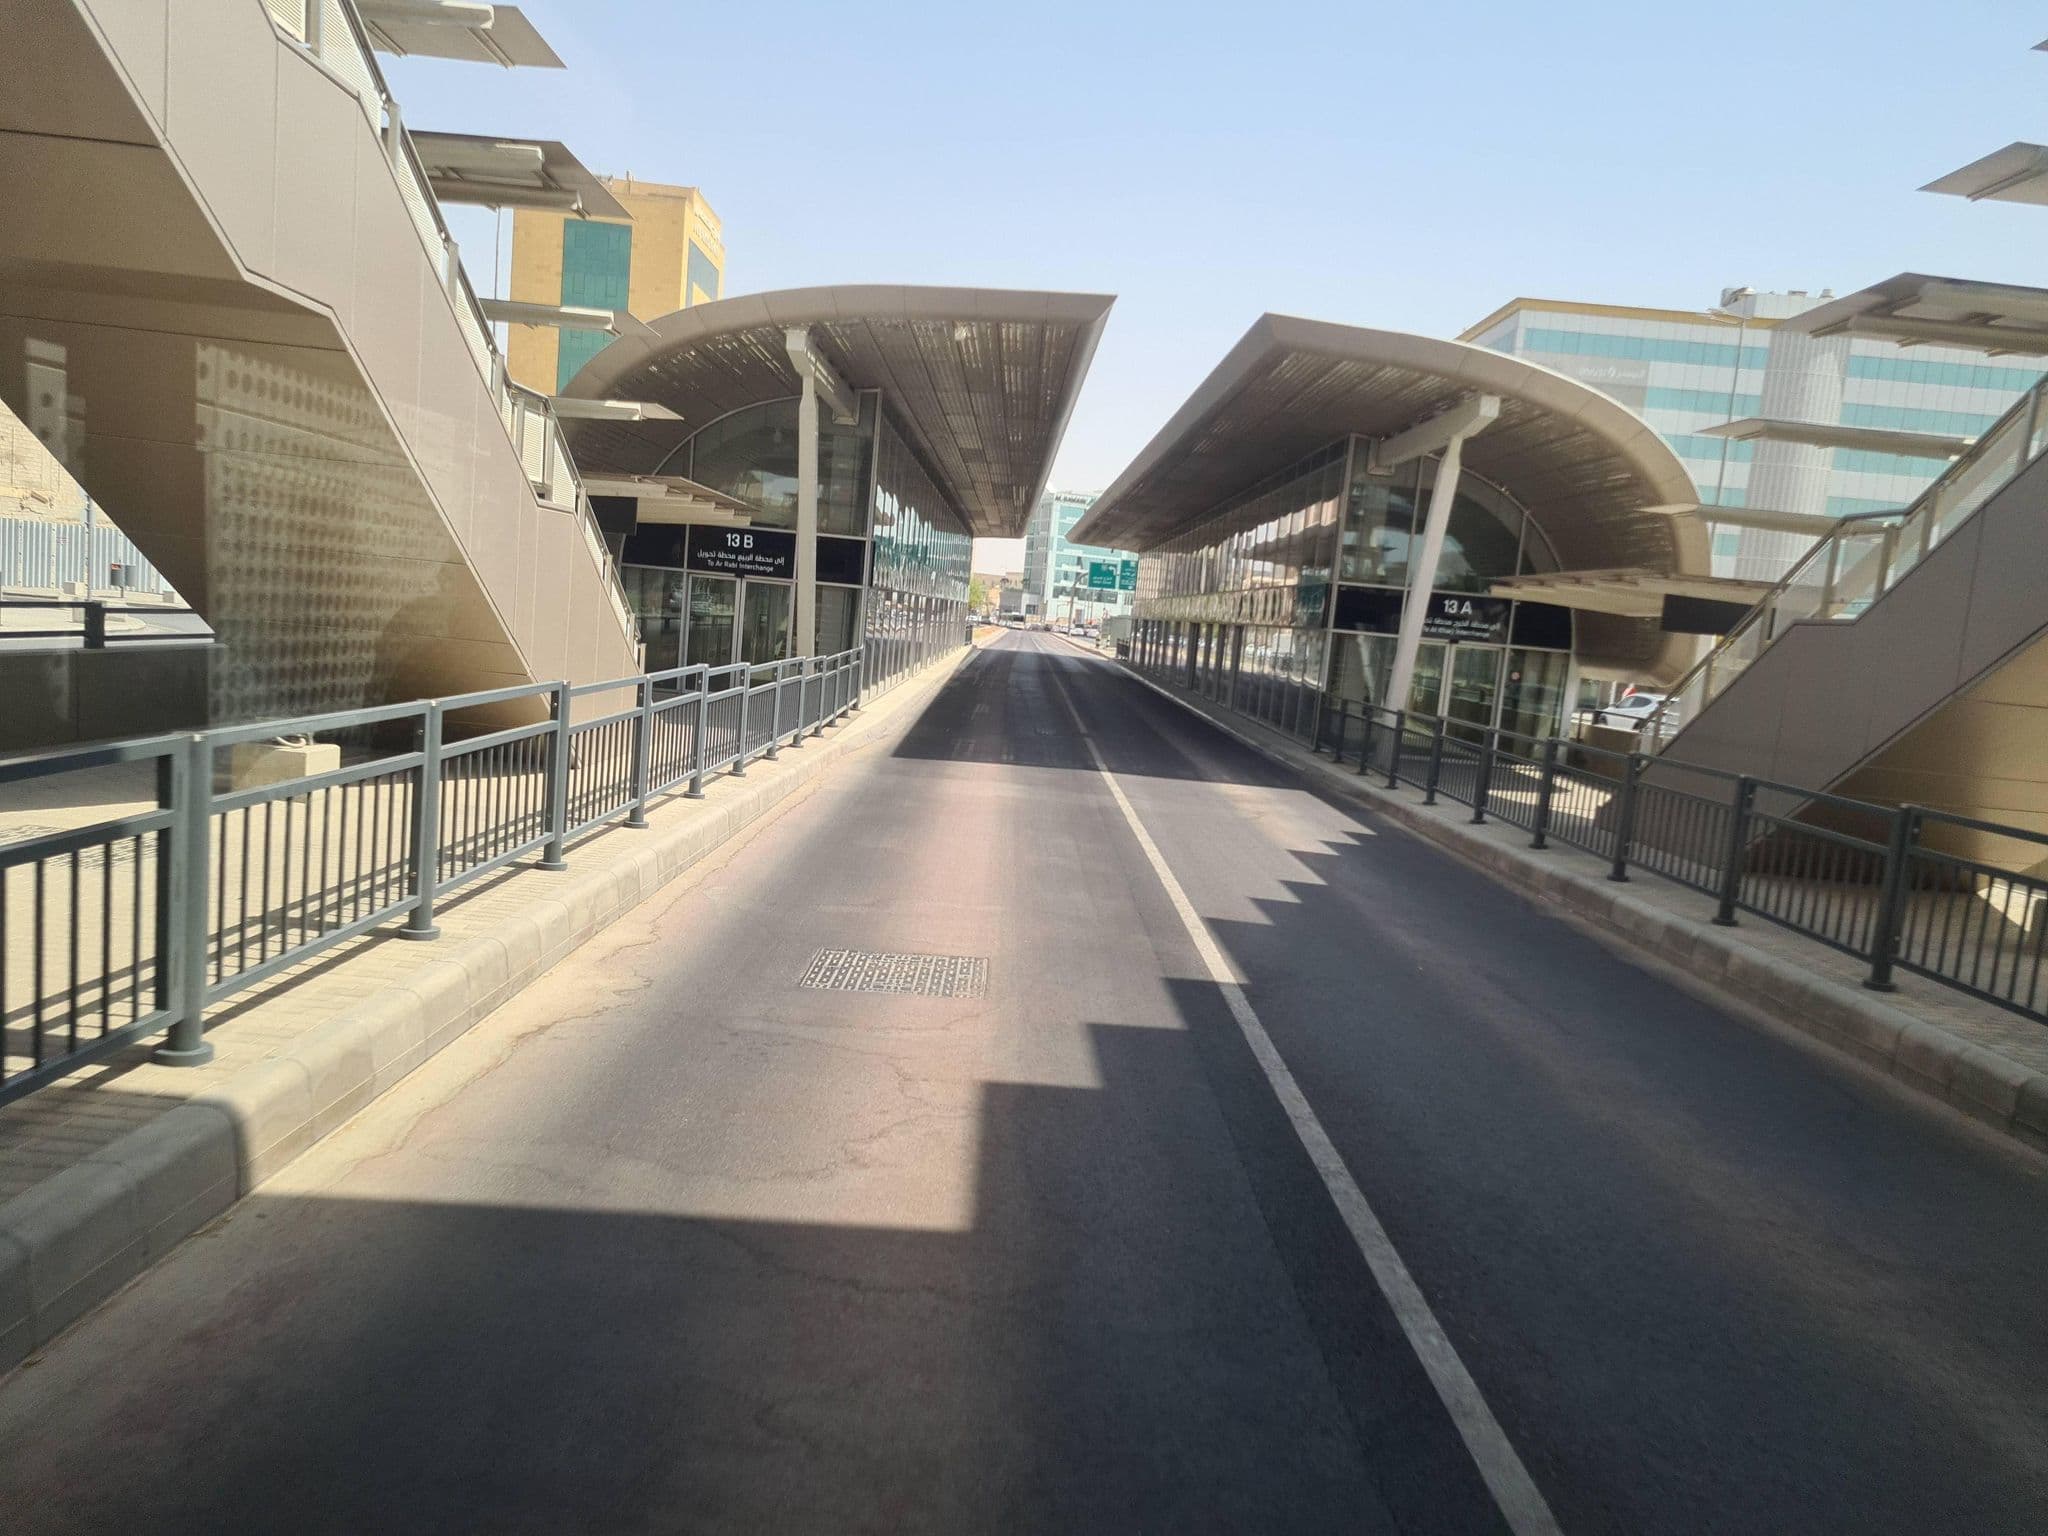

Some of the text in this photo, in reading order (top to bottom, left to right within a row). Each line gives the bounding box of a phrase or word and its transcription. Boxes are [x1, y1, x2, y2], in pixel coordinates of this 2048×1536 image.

[726, 533, 753, 548] 13 B
[697, 548, 716, 559] تحويل
[717, 550, 736, 560] محطة
[755, 554, 773, 563] محطة
[707, 559, 714, 567] To
[739, 563, 774, 573] Interchange
[774, 557, 785, 566] إلى
[1444, 600, 1472, 615] 13 A
